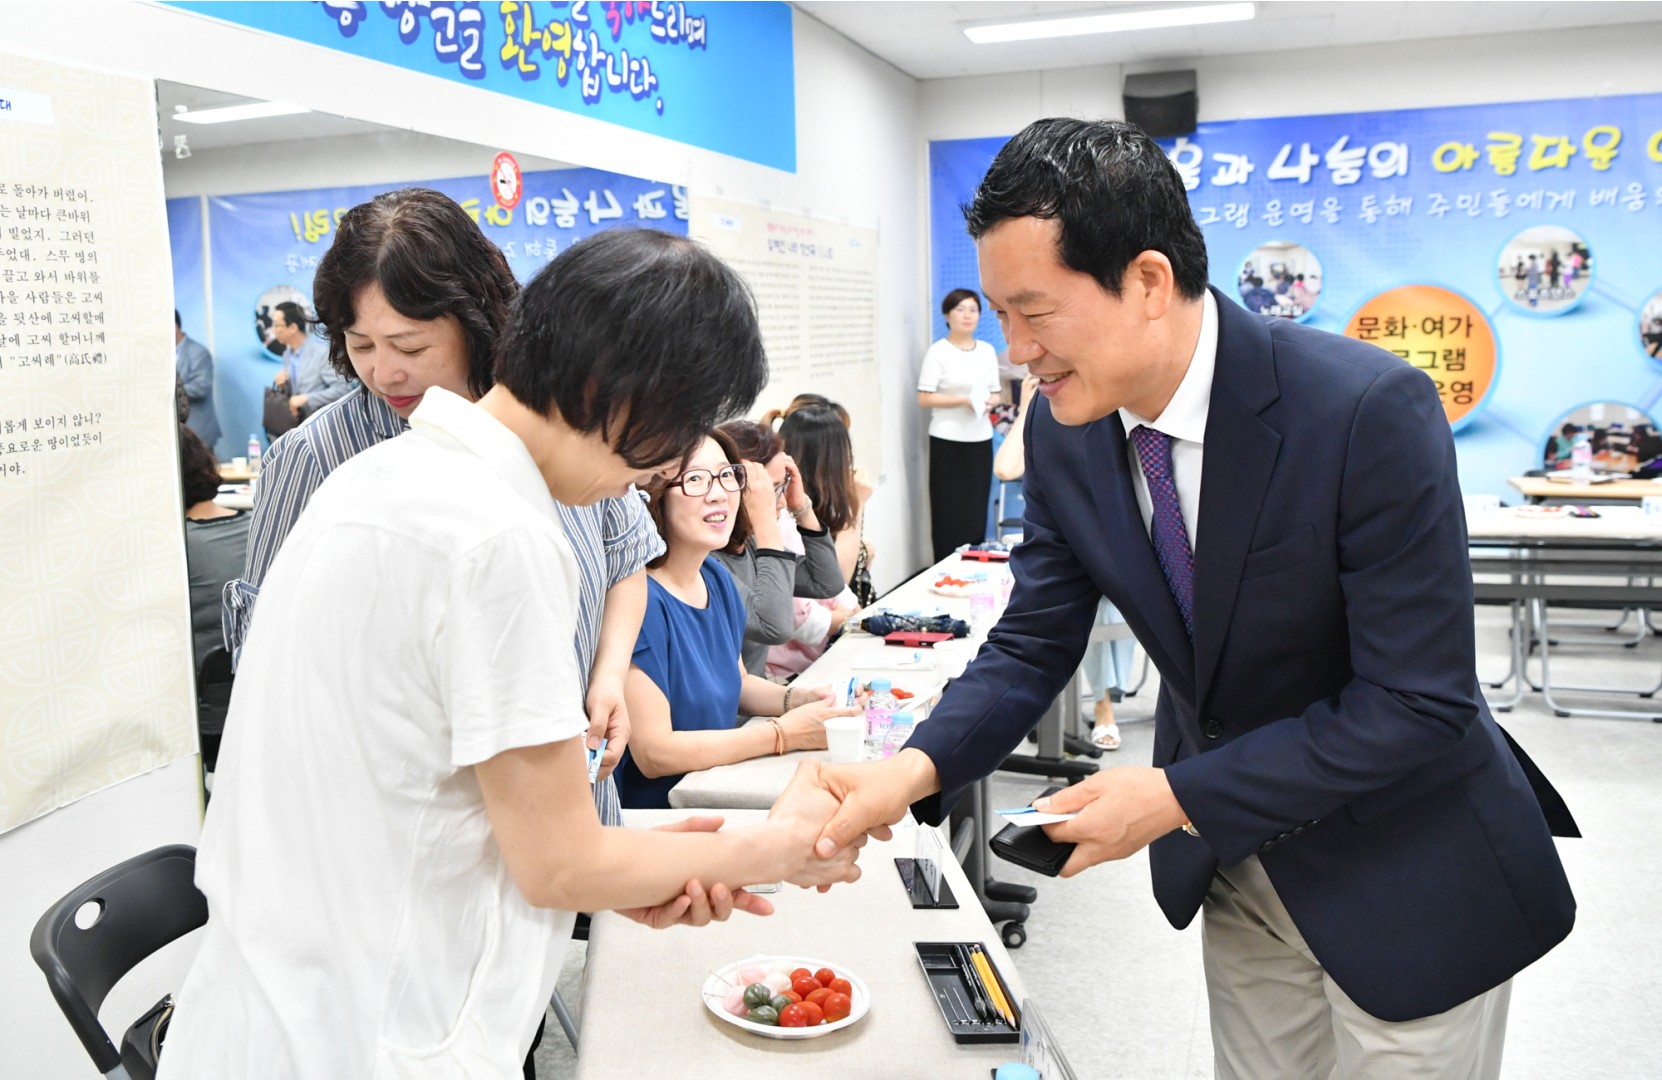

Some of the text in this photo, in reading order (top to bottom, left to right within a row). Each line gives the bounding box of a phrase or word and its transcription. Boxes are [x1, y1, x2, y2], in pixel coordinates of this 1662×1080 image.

[500, 1, 663, 110] 환영합니다.
[1267, 135, 1409, 186] 나눔의
[1432, 125, 1623, 176] 아름다운
[13, 184, 48, 199] 돌아가
[53, 187, 93, 203] 버렸어.
[16, 205, 51, 221] 날마다
[56, 208, 90, 223] 큰바위
[1262, 197, 1343, 227] 운영을
[1359, 194, 1413, 223] 통해
[1428, 188, 1576, 218] 주민들에게
[60, 230, 95, 244] 그러던
[46, 250, 70, 263] 스무
[75, 250, 97, 264] 명의
[3, 269, 100, 285] 끌고 와서 바위를
[25, 290, 76, 304] 사람들은
[81, 291, 103, 304] 고씨
[14, 311, 52, 326] 뒷산에
[1356, 315, 1474, 340] 문화·여가
[27, 332, 52, 346] 고씨
[59, 331, 106, 345] 할머니께
[0, 412, 102, 435] 롭게 보이지 않니?
[47, 431, 102, 450] 땅이었듯이
